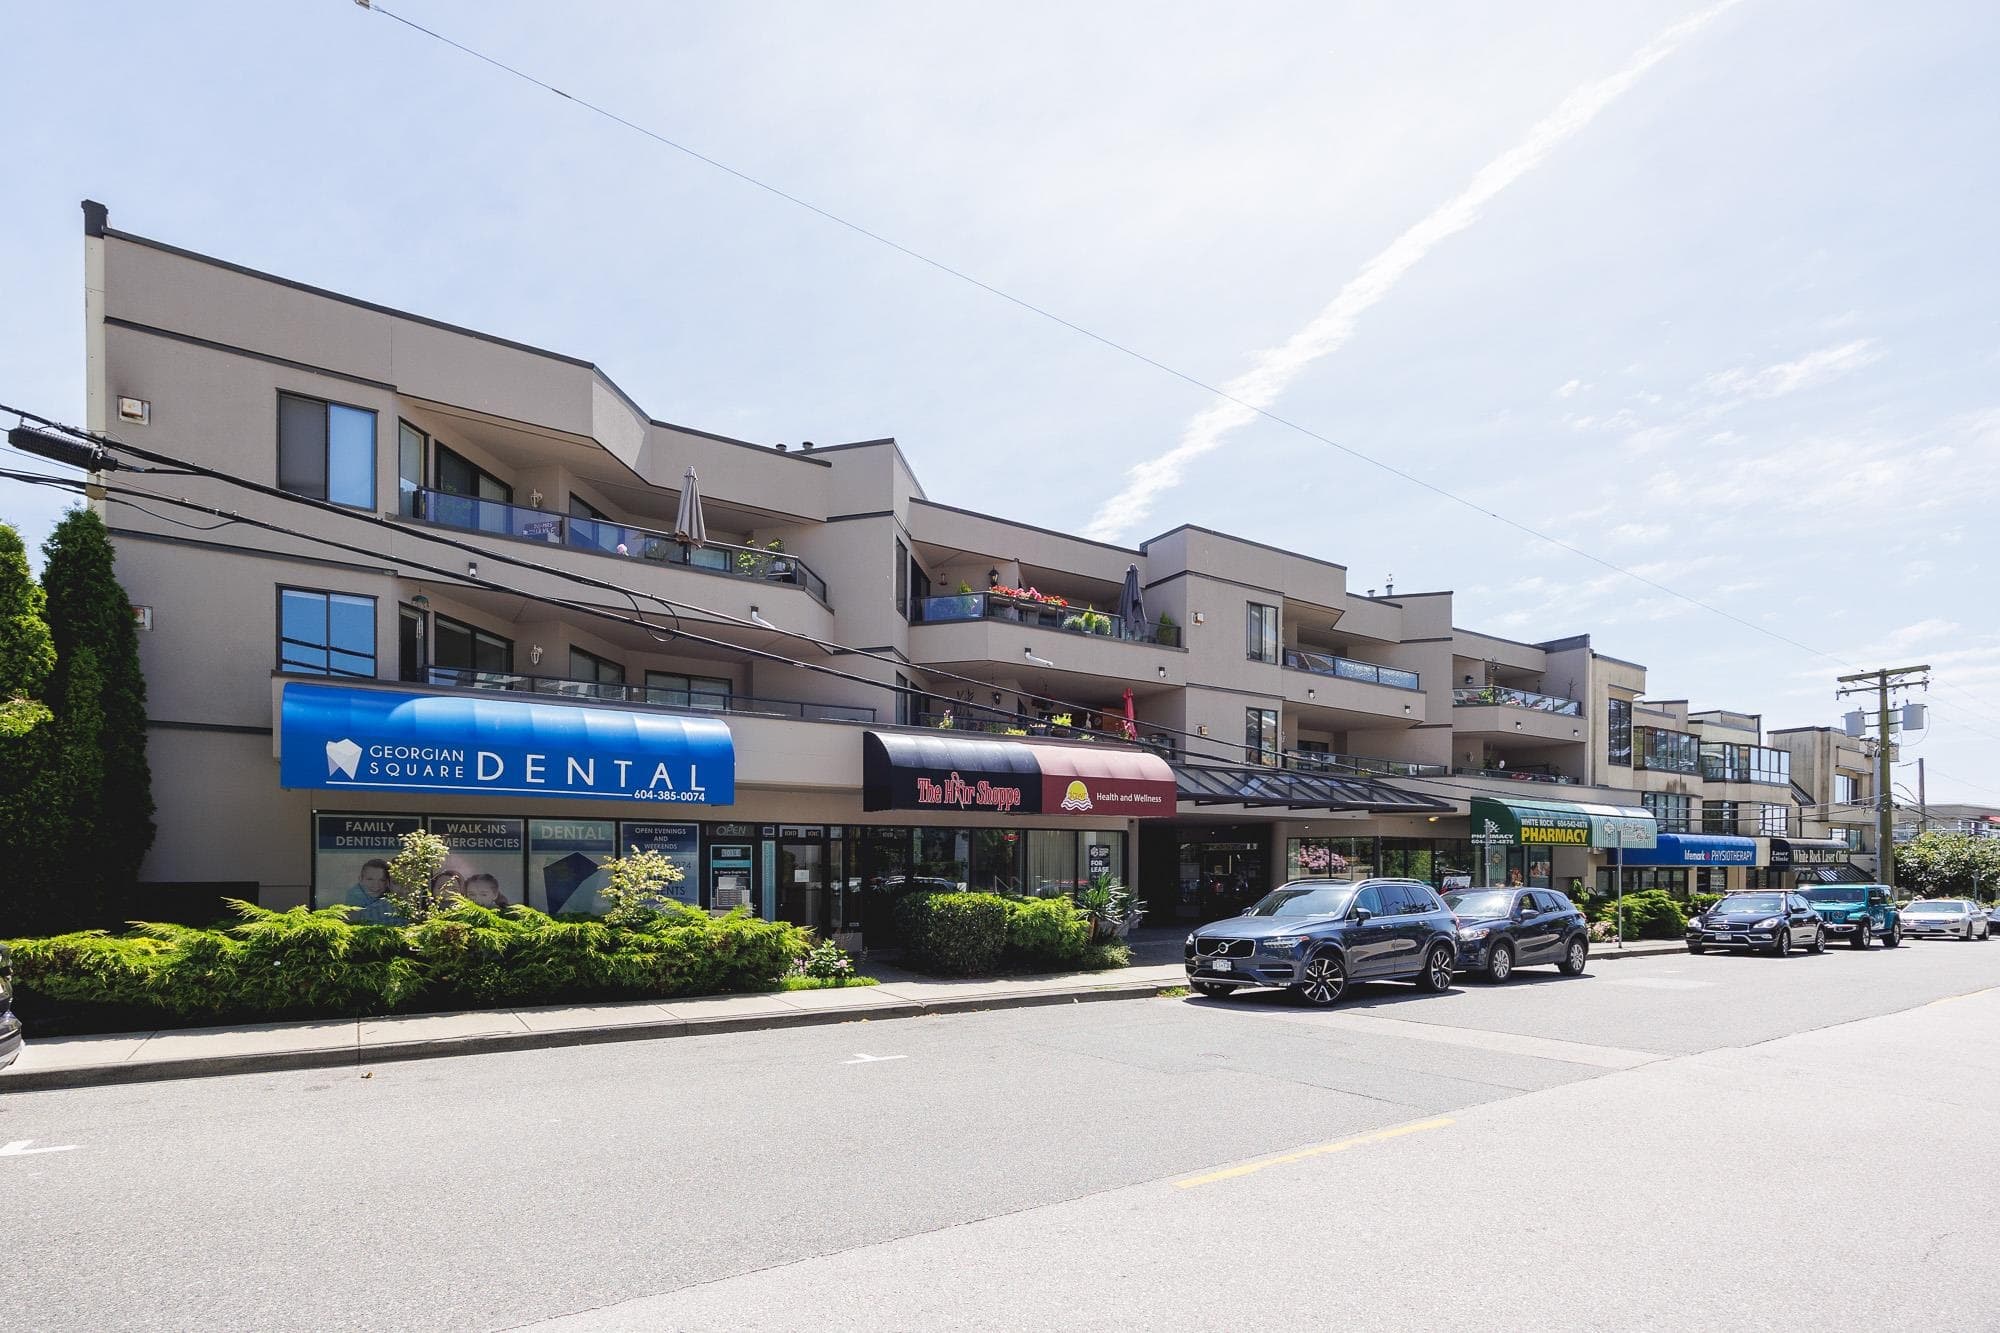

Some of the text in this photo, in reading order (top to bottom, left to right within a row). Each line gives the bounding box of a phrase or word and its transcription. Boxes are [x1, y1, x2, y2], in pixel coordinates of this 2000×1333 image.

[369, 745, 464, 762] GEORGIAN
[369, 762, 464, 778] SQUARE
[477, 751, 706, 792] DENTAL
[634, 789, 705, 802] 604-385-0074
[917, 777, 942, 803] The
[976, 780, 1021, 811] Shoppe
[1096, 792, 1119, 802] Health
[1120, 793, 1133, 802] and
[1133, 794, 1162, 803] Wellness
[345, 821, 395, 832] FAMILY
[447, 823, 507, 834] WALK-INS
[1521, 818, 1539, 826] WHITE
[1540, 819, 1555, 827] ROCK
[541, 825, 606, 840] DENTAL
[715, 825, 746, 836] OPEN
[1521, 827, 1588, 843] PHARMACY
[441, 837, 520, 849] MERGENCIES
[1711, 850, 1753, 861] PHYSIOTHERAPY
[1793, 849, 1848, 863] White Rock Laser Clinic
